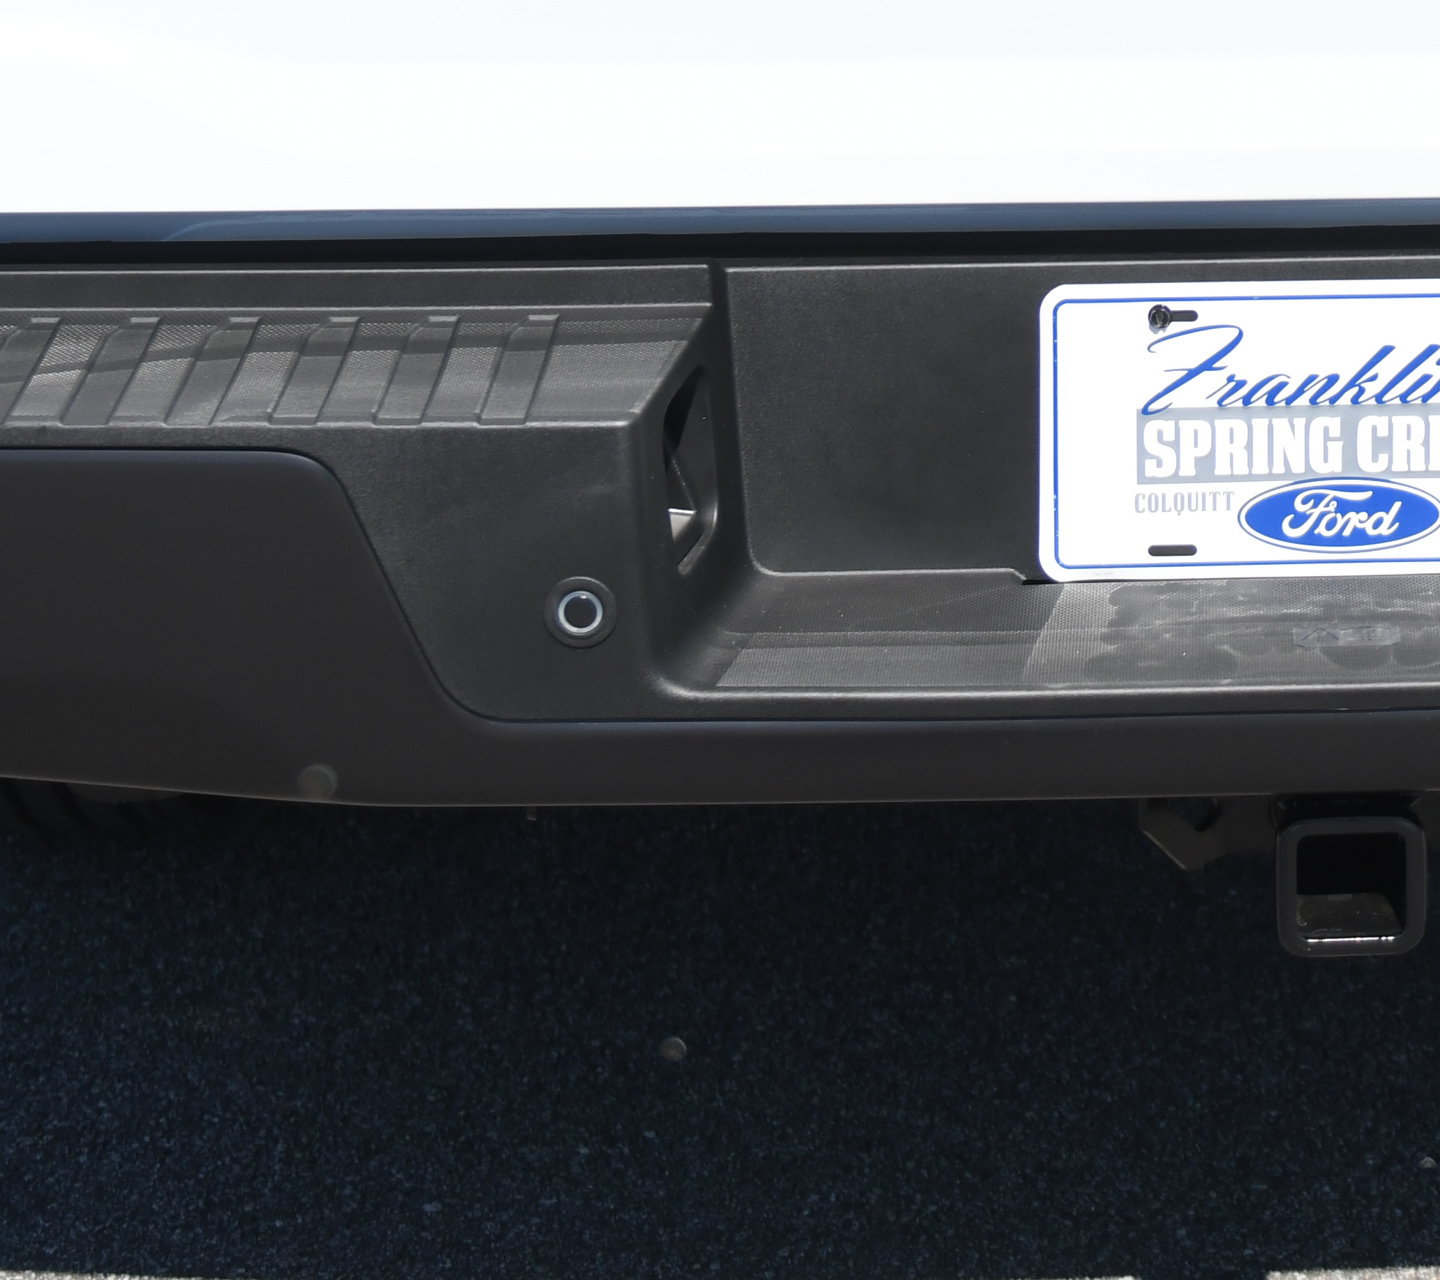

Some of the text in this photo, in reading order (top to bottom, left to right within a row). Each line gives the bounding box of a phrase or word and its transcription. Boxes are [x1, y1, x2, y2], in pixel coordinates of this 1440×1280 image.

[1142, 415, 1344, 479] SPRING
[1134, 490, 1235, 515] COLQUITT
[1280, 488, 1403, 538] Ford
